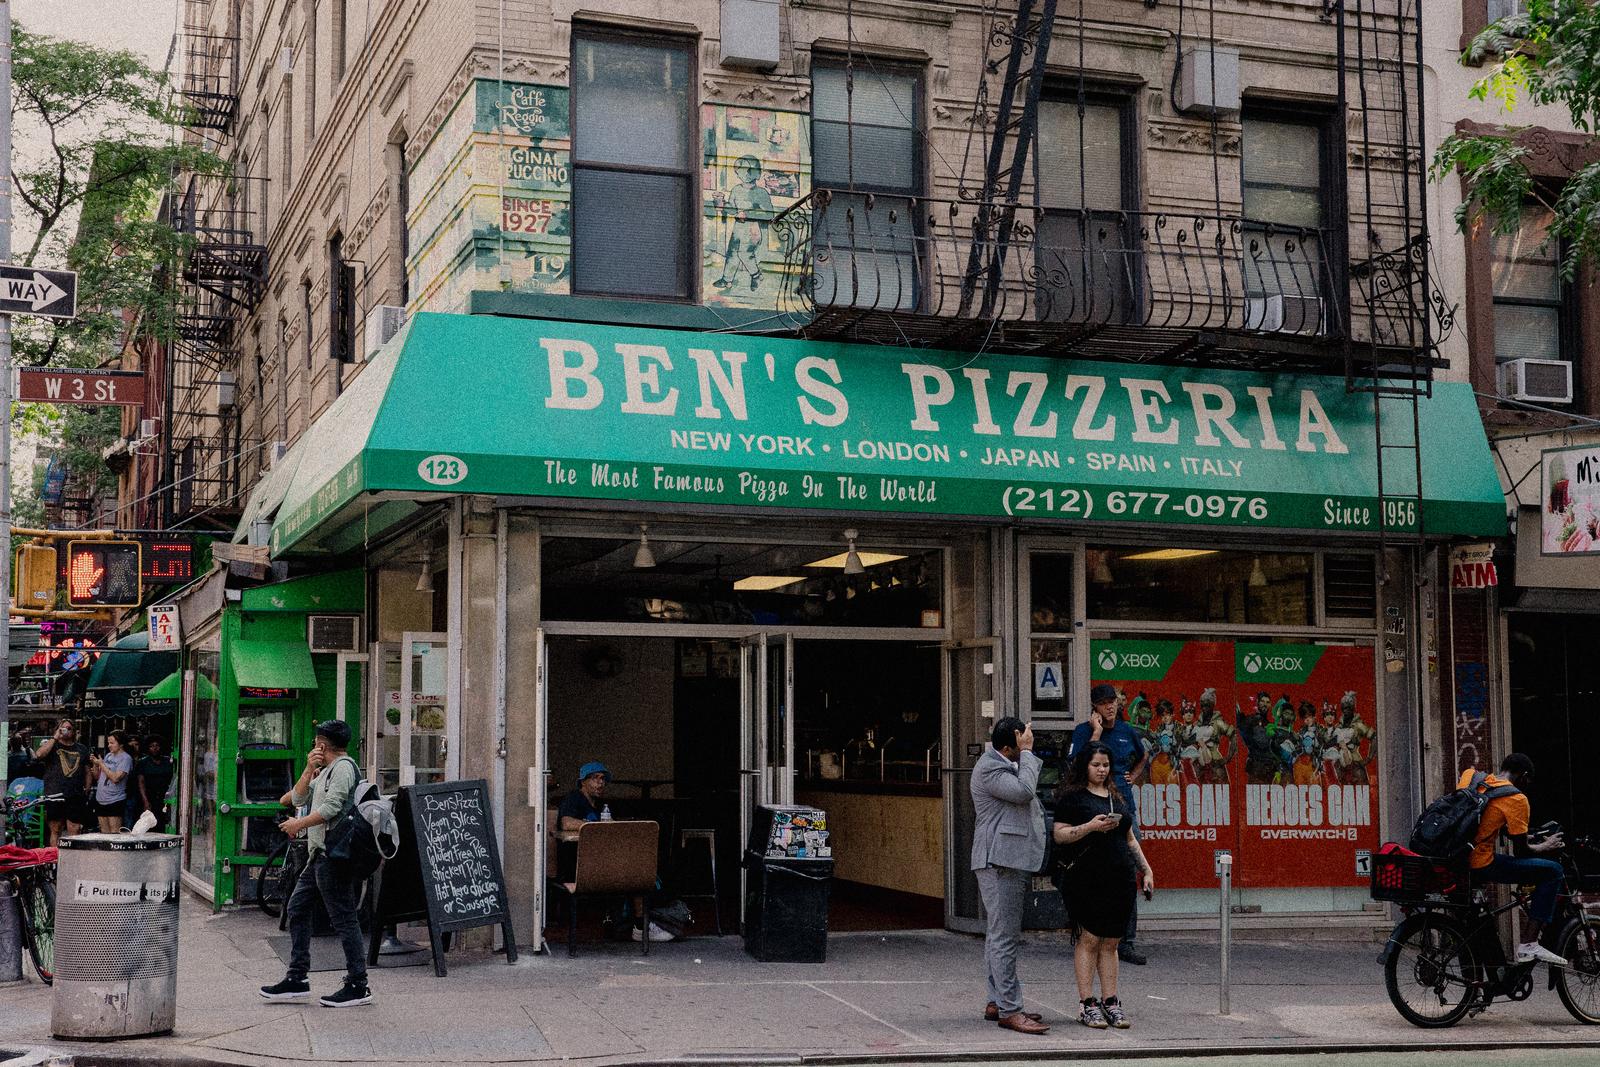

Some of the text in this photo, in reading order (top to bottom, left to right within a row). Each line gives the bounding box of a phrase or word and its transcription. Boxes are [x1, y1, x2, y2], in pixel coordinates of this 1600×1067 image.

[511, 86, 546, 108] Caffe
[501, 104, 545, 131] Reggio
[502, 199, 551, 214] SINCE
[502, 213, 551, 233] 1927
[527, 255, 565, 279] 119
[8, 281, 52, 301] WAY
[44, 378, 116, 401] W 3 St
[538, 337, 1349, 454] BEN'S PIZZERIA
[671, 430, 1243, 477] NEW YORK LONDON JAPAN SPAIN ITALY
[425, 460, 460, 479] 123
[543, 460, 937, 503] The Most Famous Pizza In The World
[1002, 486, 1268, 520] (212) 677-0976
[1324, 497, 1415, 527] Since 1956
[1452, 562, 1498, 587] ATM
[1119, 653, 1161, 669] XBOX
[1264, 656, 1303, 672] XBOX
[1040, 666, 1058, 688] A
[1186, 783, 1230, 827] CAN
[1245, 784, 1371, 827] HEROES CAN
[450, 828, 476, 843] Pie
[1260, 829, 1346, 841] OVERWATCH
[469, 838, 490, 858] Pie
[92, 887, 110, 896] Put
[112, 887, 138, 896] litter
[150, 888, 161, 896] its
[434, 882, 450, 901] Hot
[443, 900, 454, 914] or
